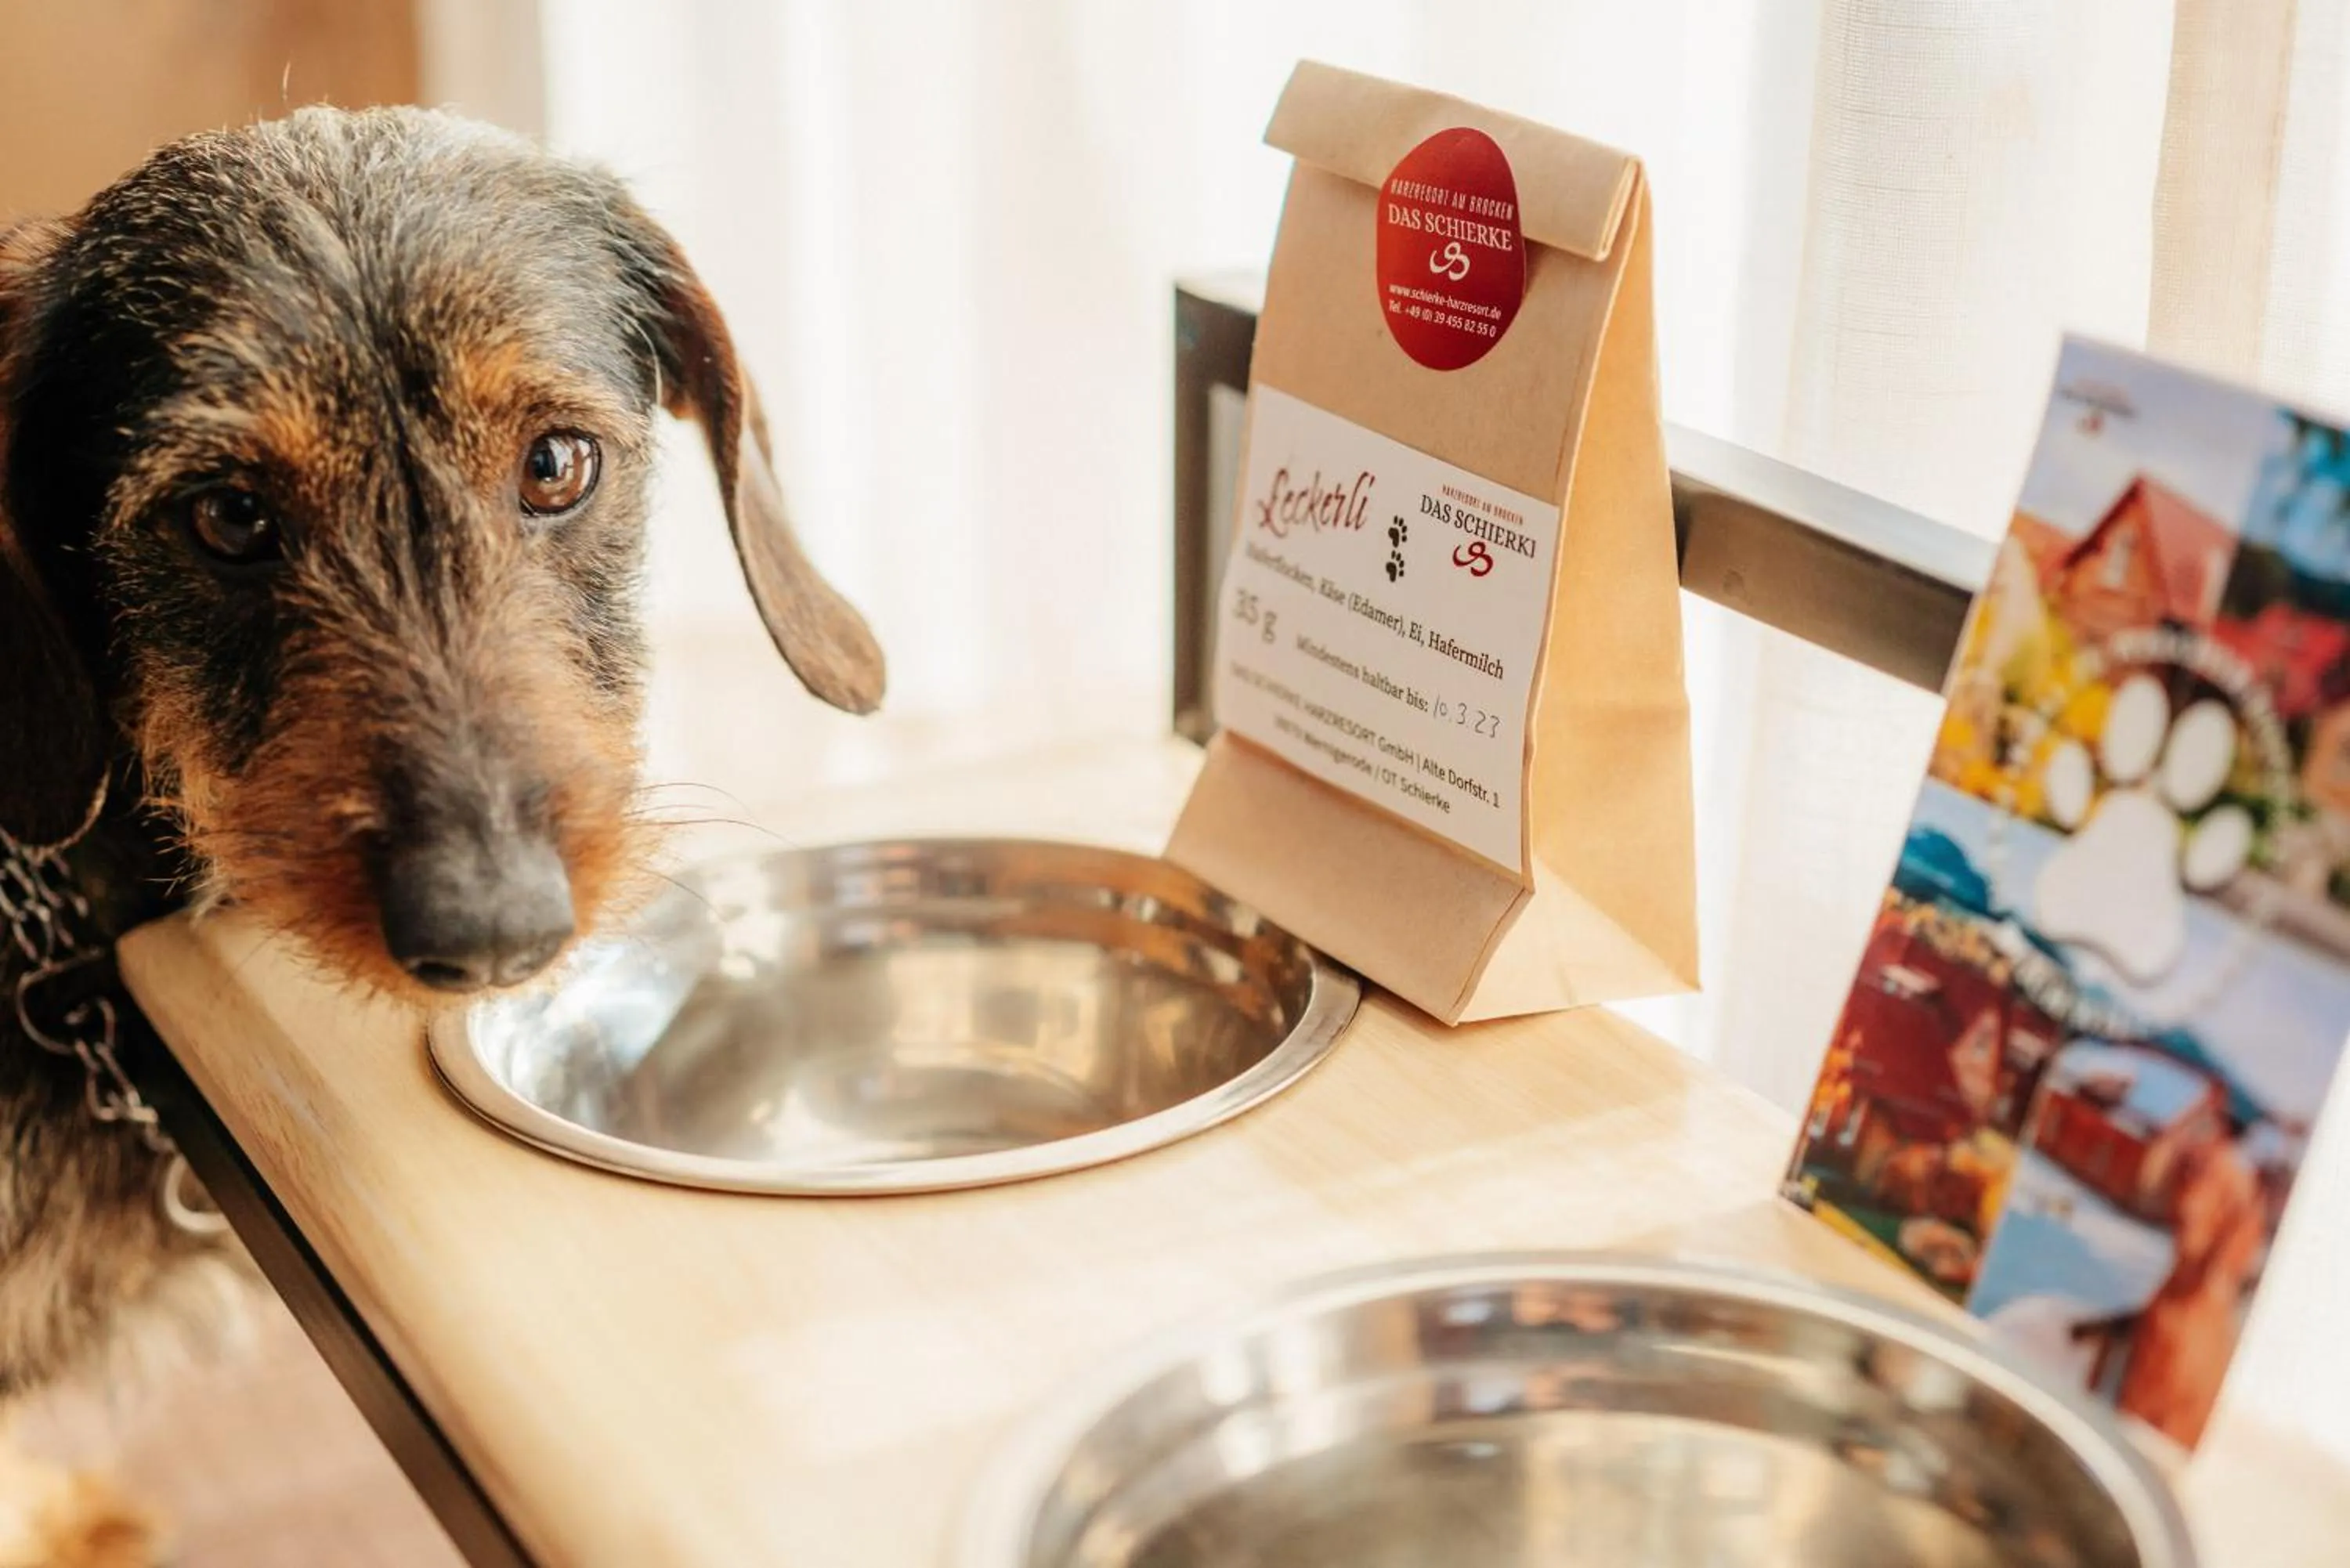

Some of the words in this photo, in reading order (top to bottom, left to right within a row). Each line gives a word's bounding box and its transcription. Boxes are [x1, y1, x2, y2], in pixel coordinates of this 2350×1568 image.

[1391, 179, 1449, 206] HARZRESORT
[1452, 191, 1466, 210] AM
[1469, 195, 1514, 221] BROCKEN
[1389, 204, 1421, 230] DAS
[1425, 212, 1513, 251] SCHIERKE
[1389, 284, 1502, 320] www.schierke-harzresort.de
[1389, 299, 1401, 314] Tel.
[1405, 305, 1421, 318] +49
[1422, 308, 1433, 321] (0)
[1434, 311, 1445, 324] 39
[1446, 314, 1462, 329] 455
[1464, 319, 1476, 333] 82
[1477, 322, 1488, 335] 55
[1489, 325, 1497, 338] 0
[1256, 468, 1376, 539] Leckerli
[1420, 494, 1452, 524] DAS
[1347, 592, 1406, 638] (Edamer),
[1409, 621, 1426, 648] Ei,
[1428, 630, 1504, 680] Hafermilch
[1361, 666, 1404, 701] haltbar
[1406, 687, 1429, 713] bis:
[1378, 736, 1414, 765] GmbH
[1422, 757, 1445, 781] Alte
[1448, 768, 1490, 804] Dorfstr.
[1493, 792, 1500, 808] 1
[1401, 776, 1451, 814] Schierke
